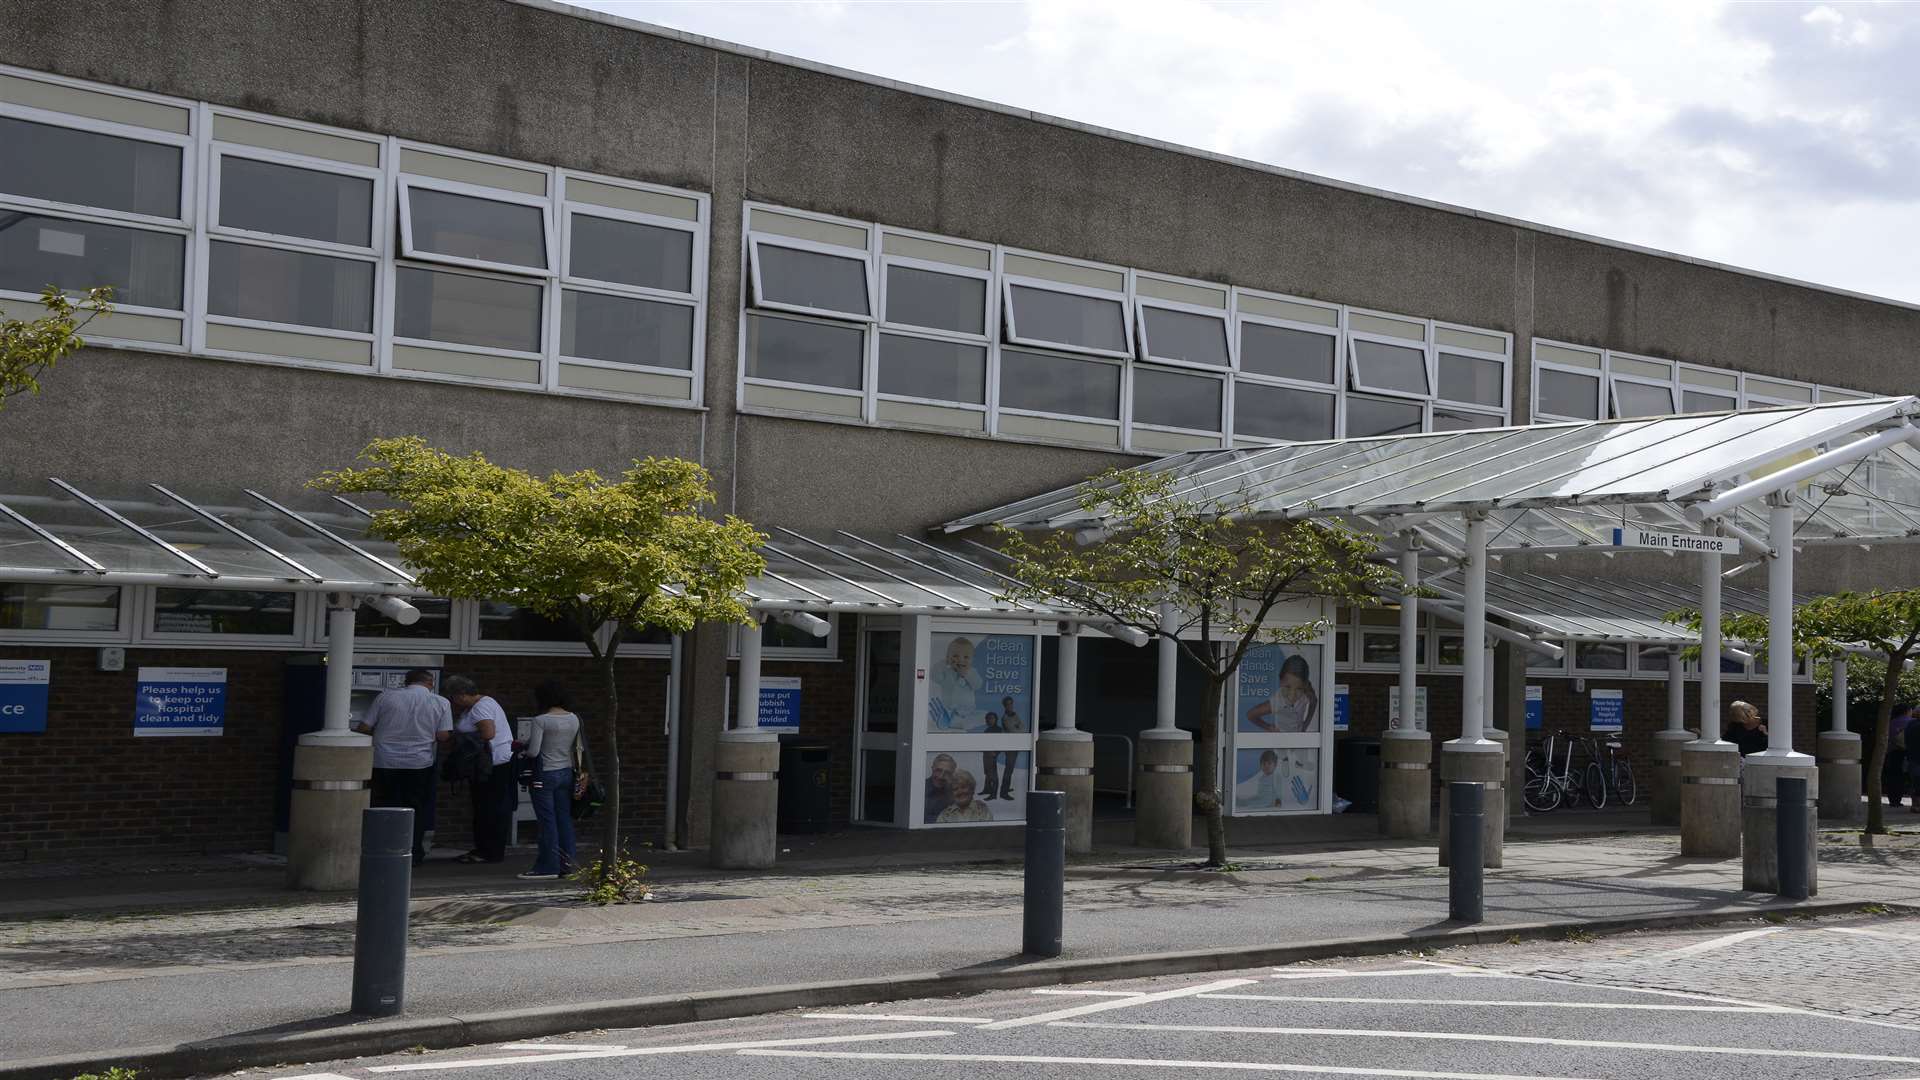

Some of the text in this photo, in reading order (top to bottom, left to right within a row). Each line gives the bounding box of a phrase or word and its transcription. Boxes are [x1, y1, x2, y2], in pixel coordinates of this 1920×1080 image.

[1639, 532, 1723, 551] Main Entrance
[986, 639, 1024, 651] Clean
[986, 653, 1027, 666] Hands
[1240, 659, 1275, 672] Hands
[985, 667, 1019, 680] Save
[1240, 672, 1269, 684] Save
[142, 686, 178, 694] Please
[181, 685, 205, 695] help
[985, 680, 1022, 694] Lives
[1240, 684, 1271, 697] Lives
[165, 695, 192, 704] keep
[158, 705, 204, 715] Hospital
[140, 714, 220, 724] clean and tidy
